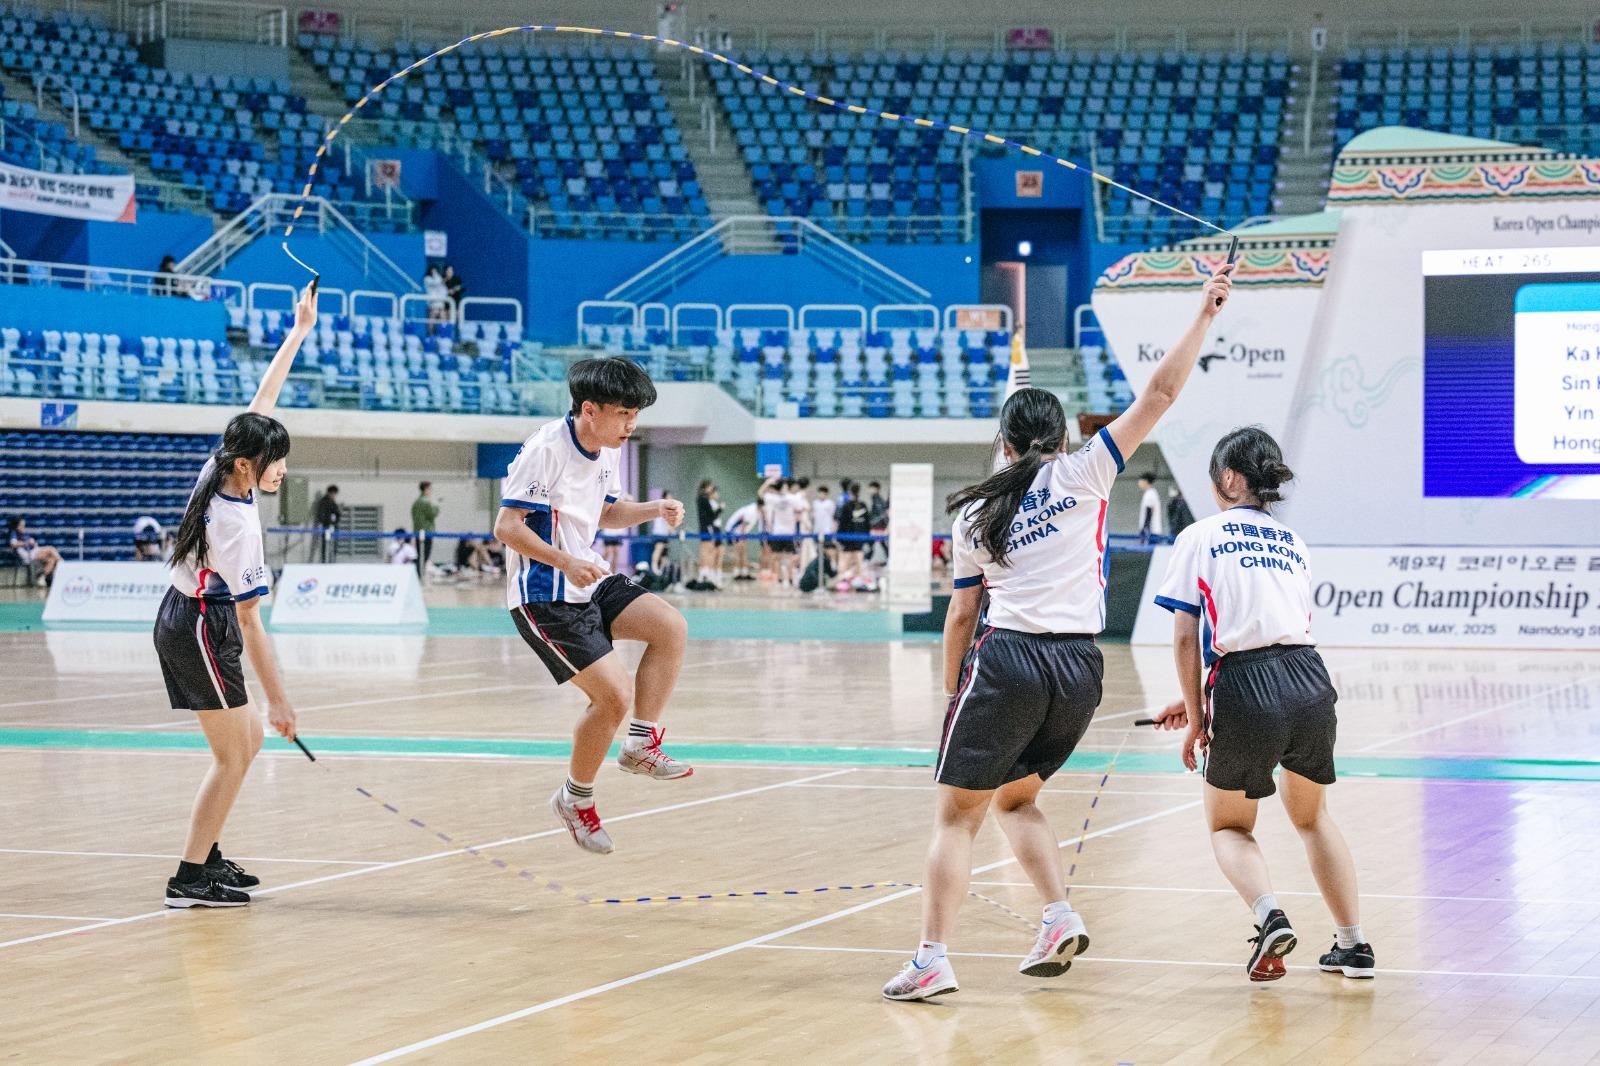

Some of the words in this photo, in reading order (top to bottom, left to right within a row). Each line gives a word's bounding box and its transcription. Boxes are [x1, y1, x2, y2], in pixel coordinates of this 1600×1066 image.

[1493, 216, 1524, 231] Korea
[1526, 215, 1554, 235] Open
[1462, 256, 1503, 268] HEAT
[1522, 255, 1552, 268] 265
[1230, 343, 1285, 367] Open
[1566, 345, 1590, 361] Ka
[1562, 375, 1590, 391] Sin
[1564, 404, 1594, 420] Yin
[1027, 496, 1077, 527] KONG
[1005, 522, 1059, 553] CHINA
[1222, 522, 1294, 546] 中國香港
[1210, 541, 1263, 558] HONG
[1240, 556, 1294, 574] CHINA
[1388, 555, 1446, 571] 제9회
[1456, 555, 1577, 572] 코리아오픈
[1314, 581, 1384, 616] Open
[1393, 581, 1590, 617] Championship
[1371, 623, 1390, 635] 03
[1463, 623, 1497, 635] 2025
[1518, 624, 1585, 639] Namdong
